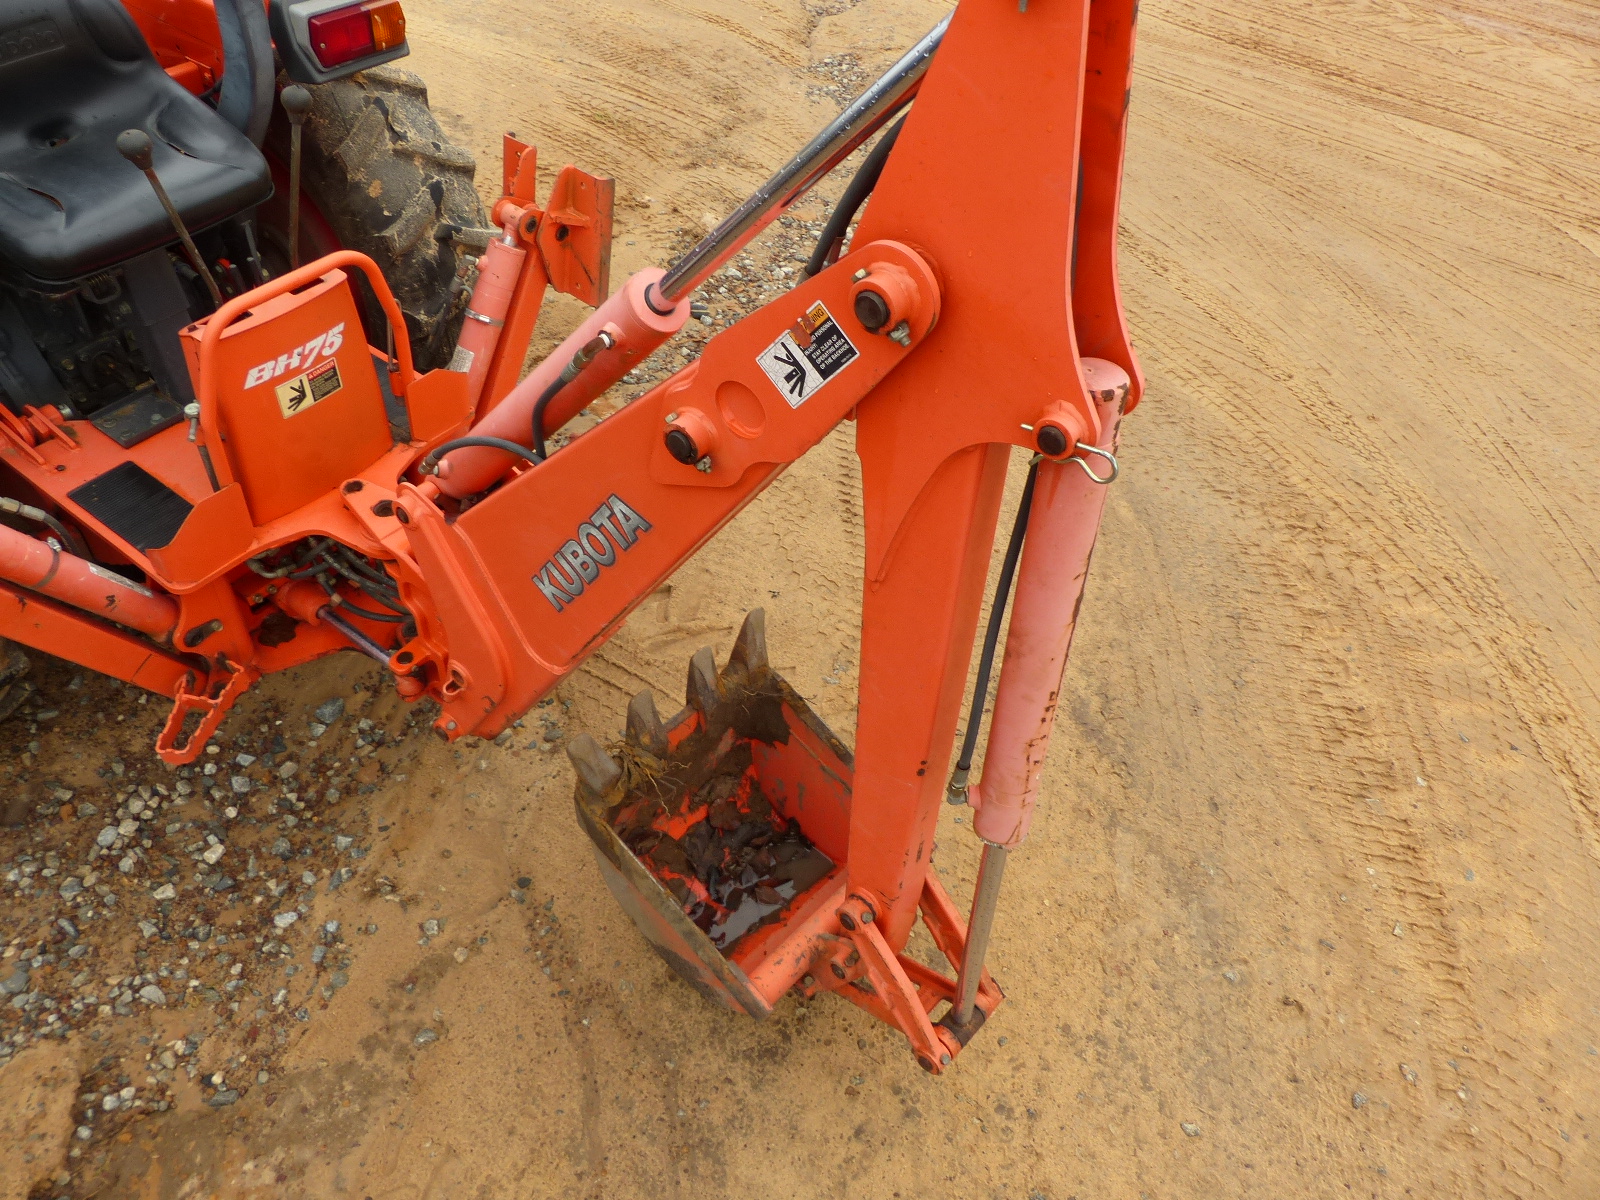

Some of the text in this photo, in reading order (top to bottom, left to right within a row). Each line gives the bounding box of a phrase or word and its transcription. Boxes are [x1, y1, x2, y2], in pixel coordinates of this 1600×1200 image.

[243, 321, 345, 390] BH75
[811, 348, 822, 359] STAY
[820, 339, 833, 351] CLEAR
[831, 334, 838, 342] OF
[815, 345, 836, 364] OPERATING
[834, 338, 846, 350] AREA
[312, 361, 335, 377] DANGER
[819, 362, 826, 370] OF
[824, 356, 834, 365] THE
[531, 493, 653, 614] KUBOTA
